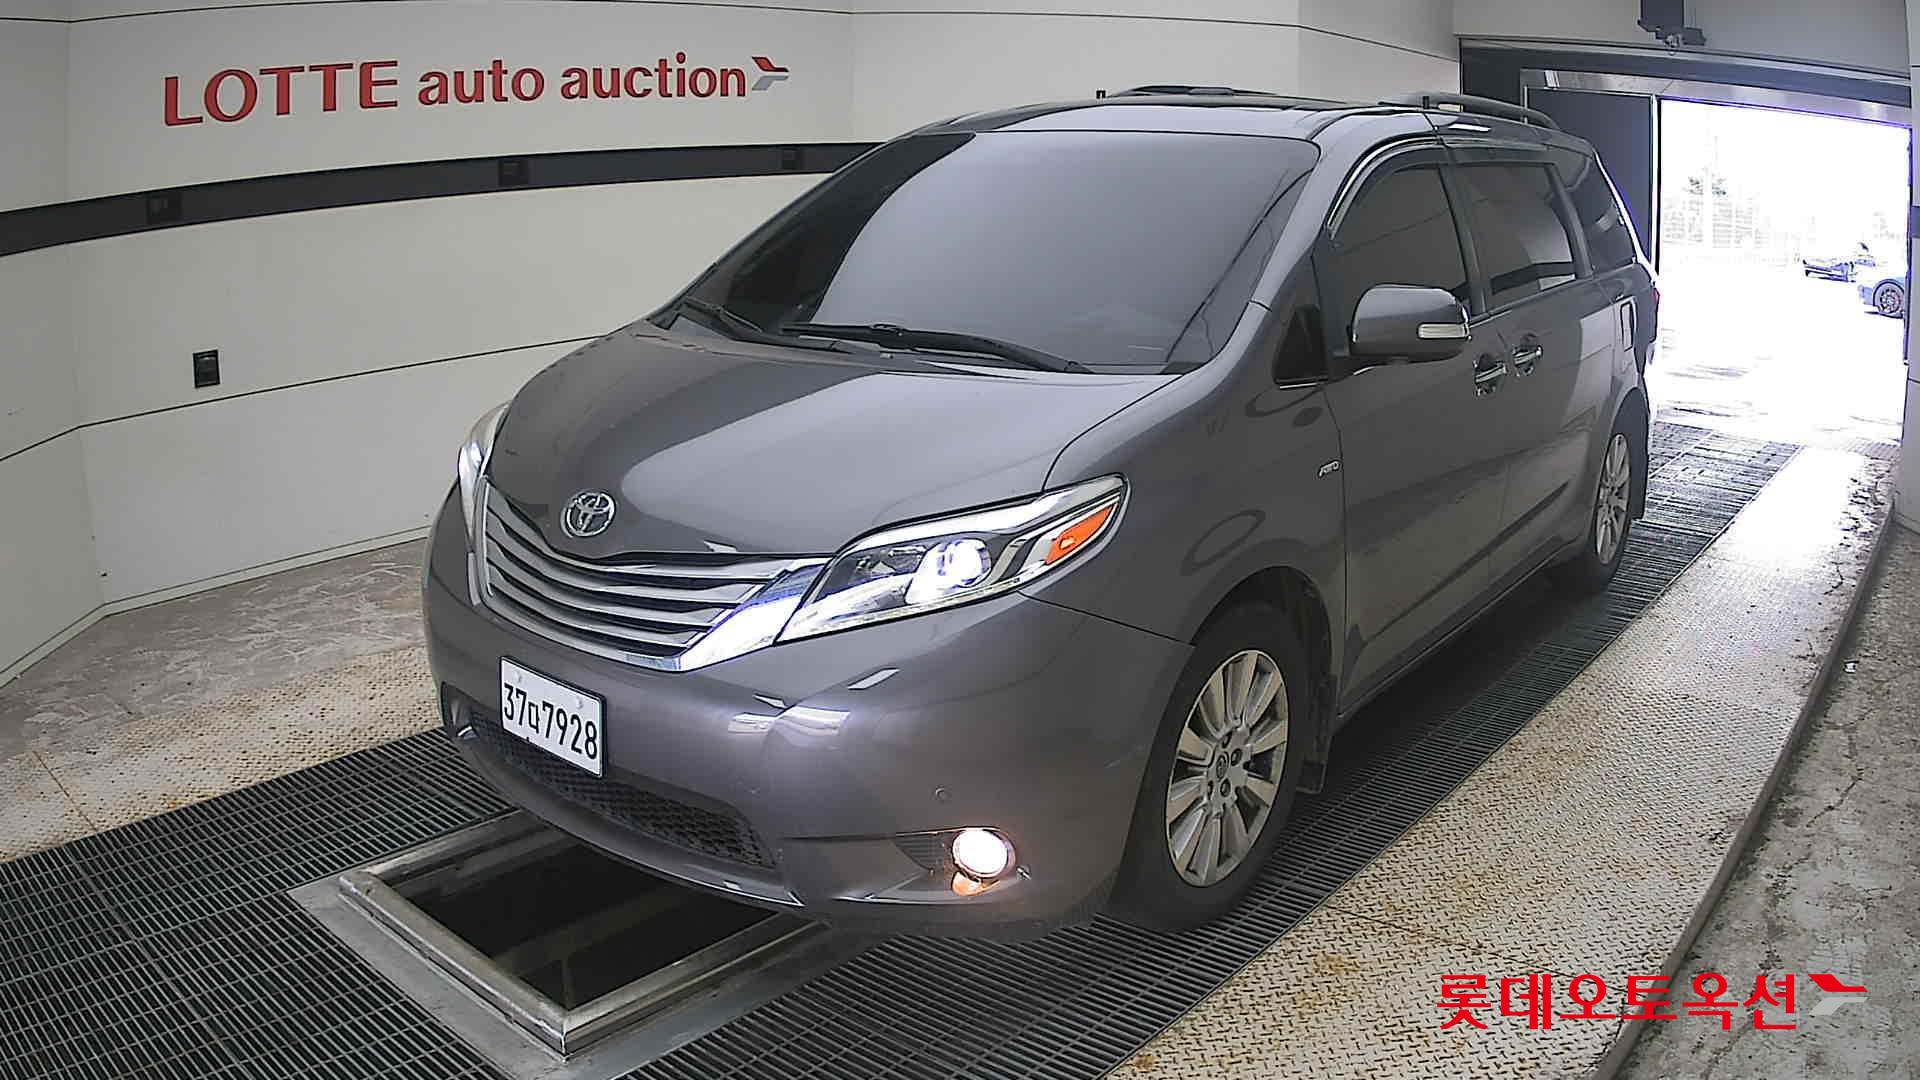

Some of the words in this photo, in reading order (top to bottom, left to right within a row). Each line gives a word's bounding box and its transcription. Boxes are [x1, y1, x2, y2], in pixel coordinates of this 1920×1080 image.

[164, 60, 399, 126] LOTTE
[418, 59, 545, 105] auto
[560, 52, 747, 99] auction
